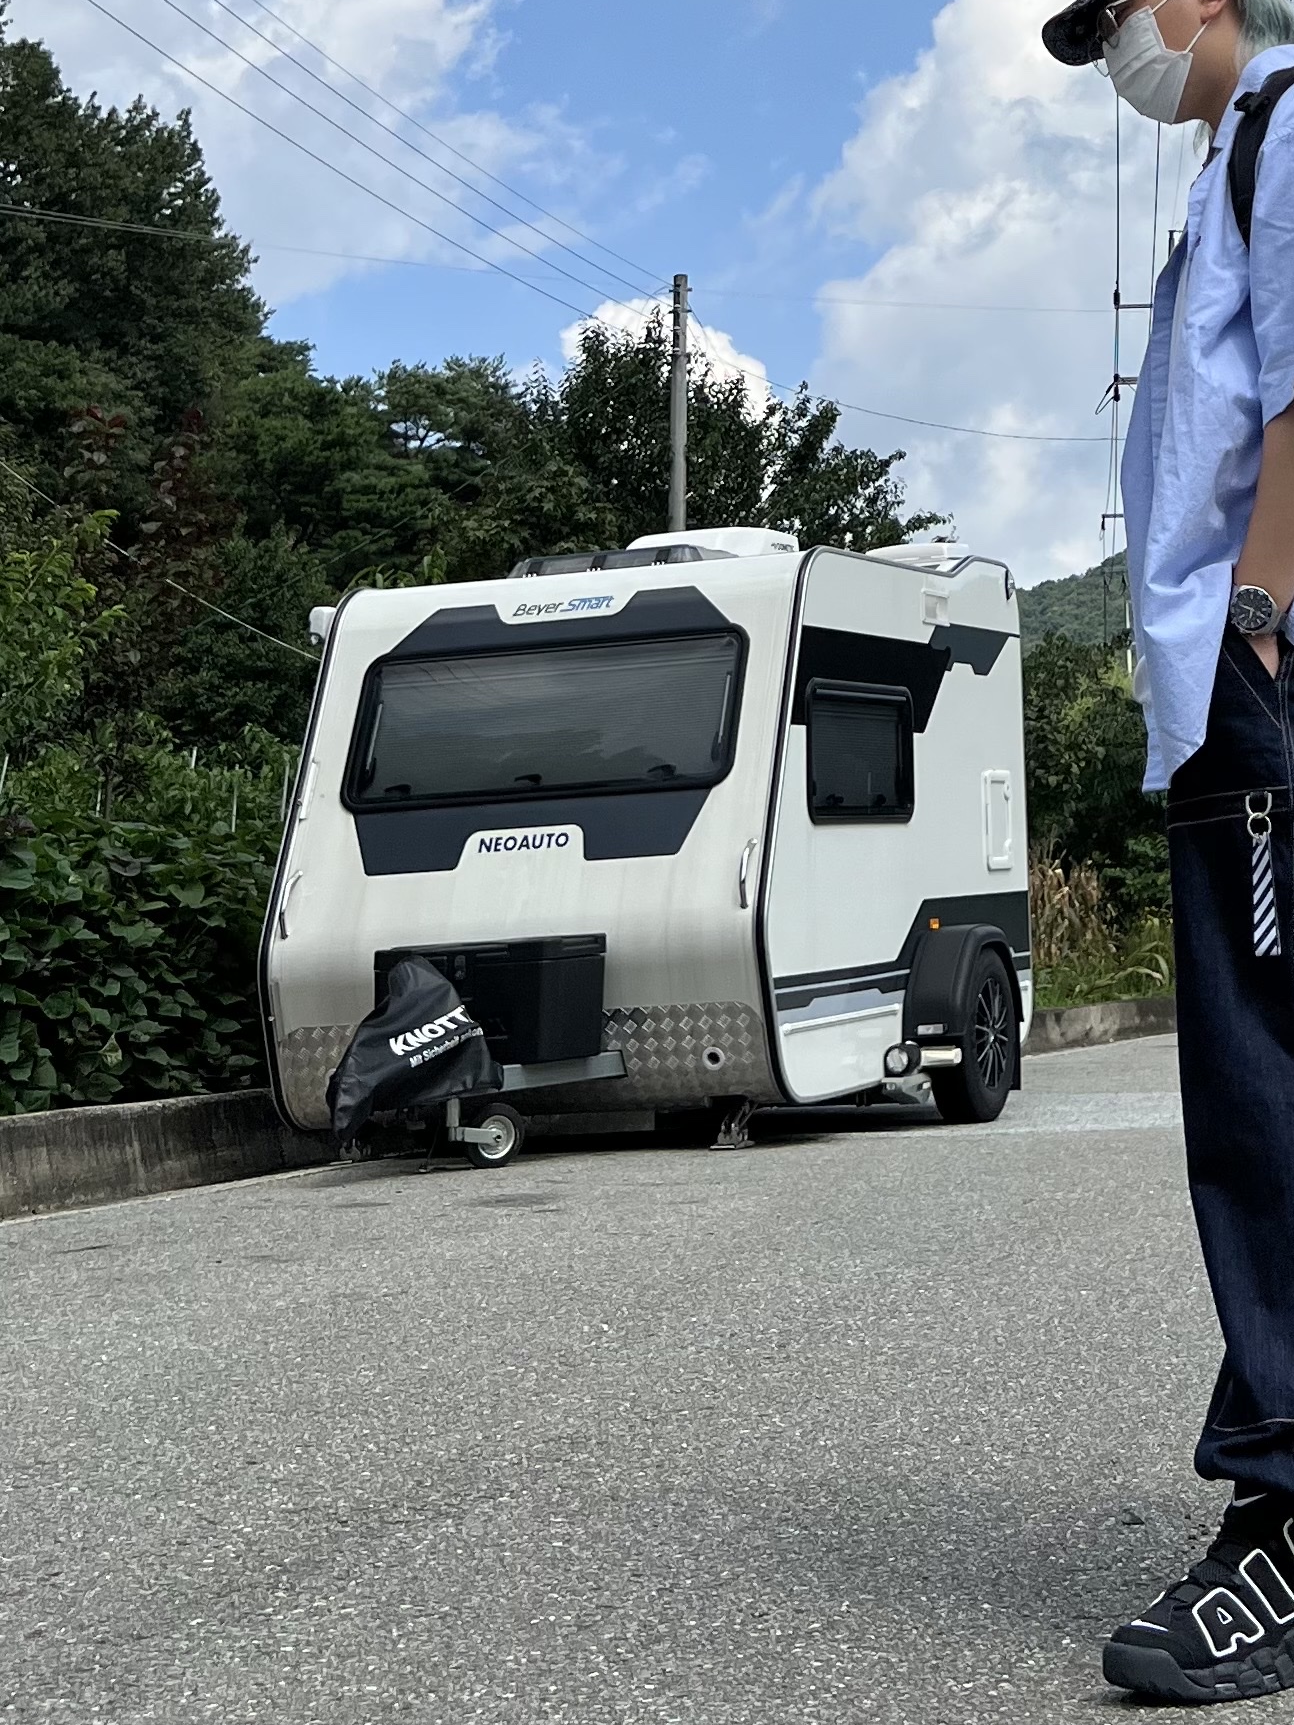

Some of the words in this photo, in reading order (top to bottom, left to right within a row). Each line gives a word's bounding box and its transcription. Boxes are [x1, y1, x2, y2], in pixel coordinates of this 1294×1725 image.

[560, 595, 614, 612] Smart
[478, 832, 569, 853] NEOAUTO
[389, 1004, 473, 1056] KNOTT
